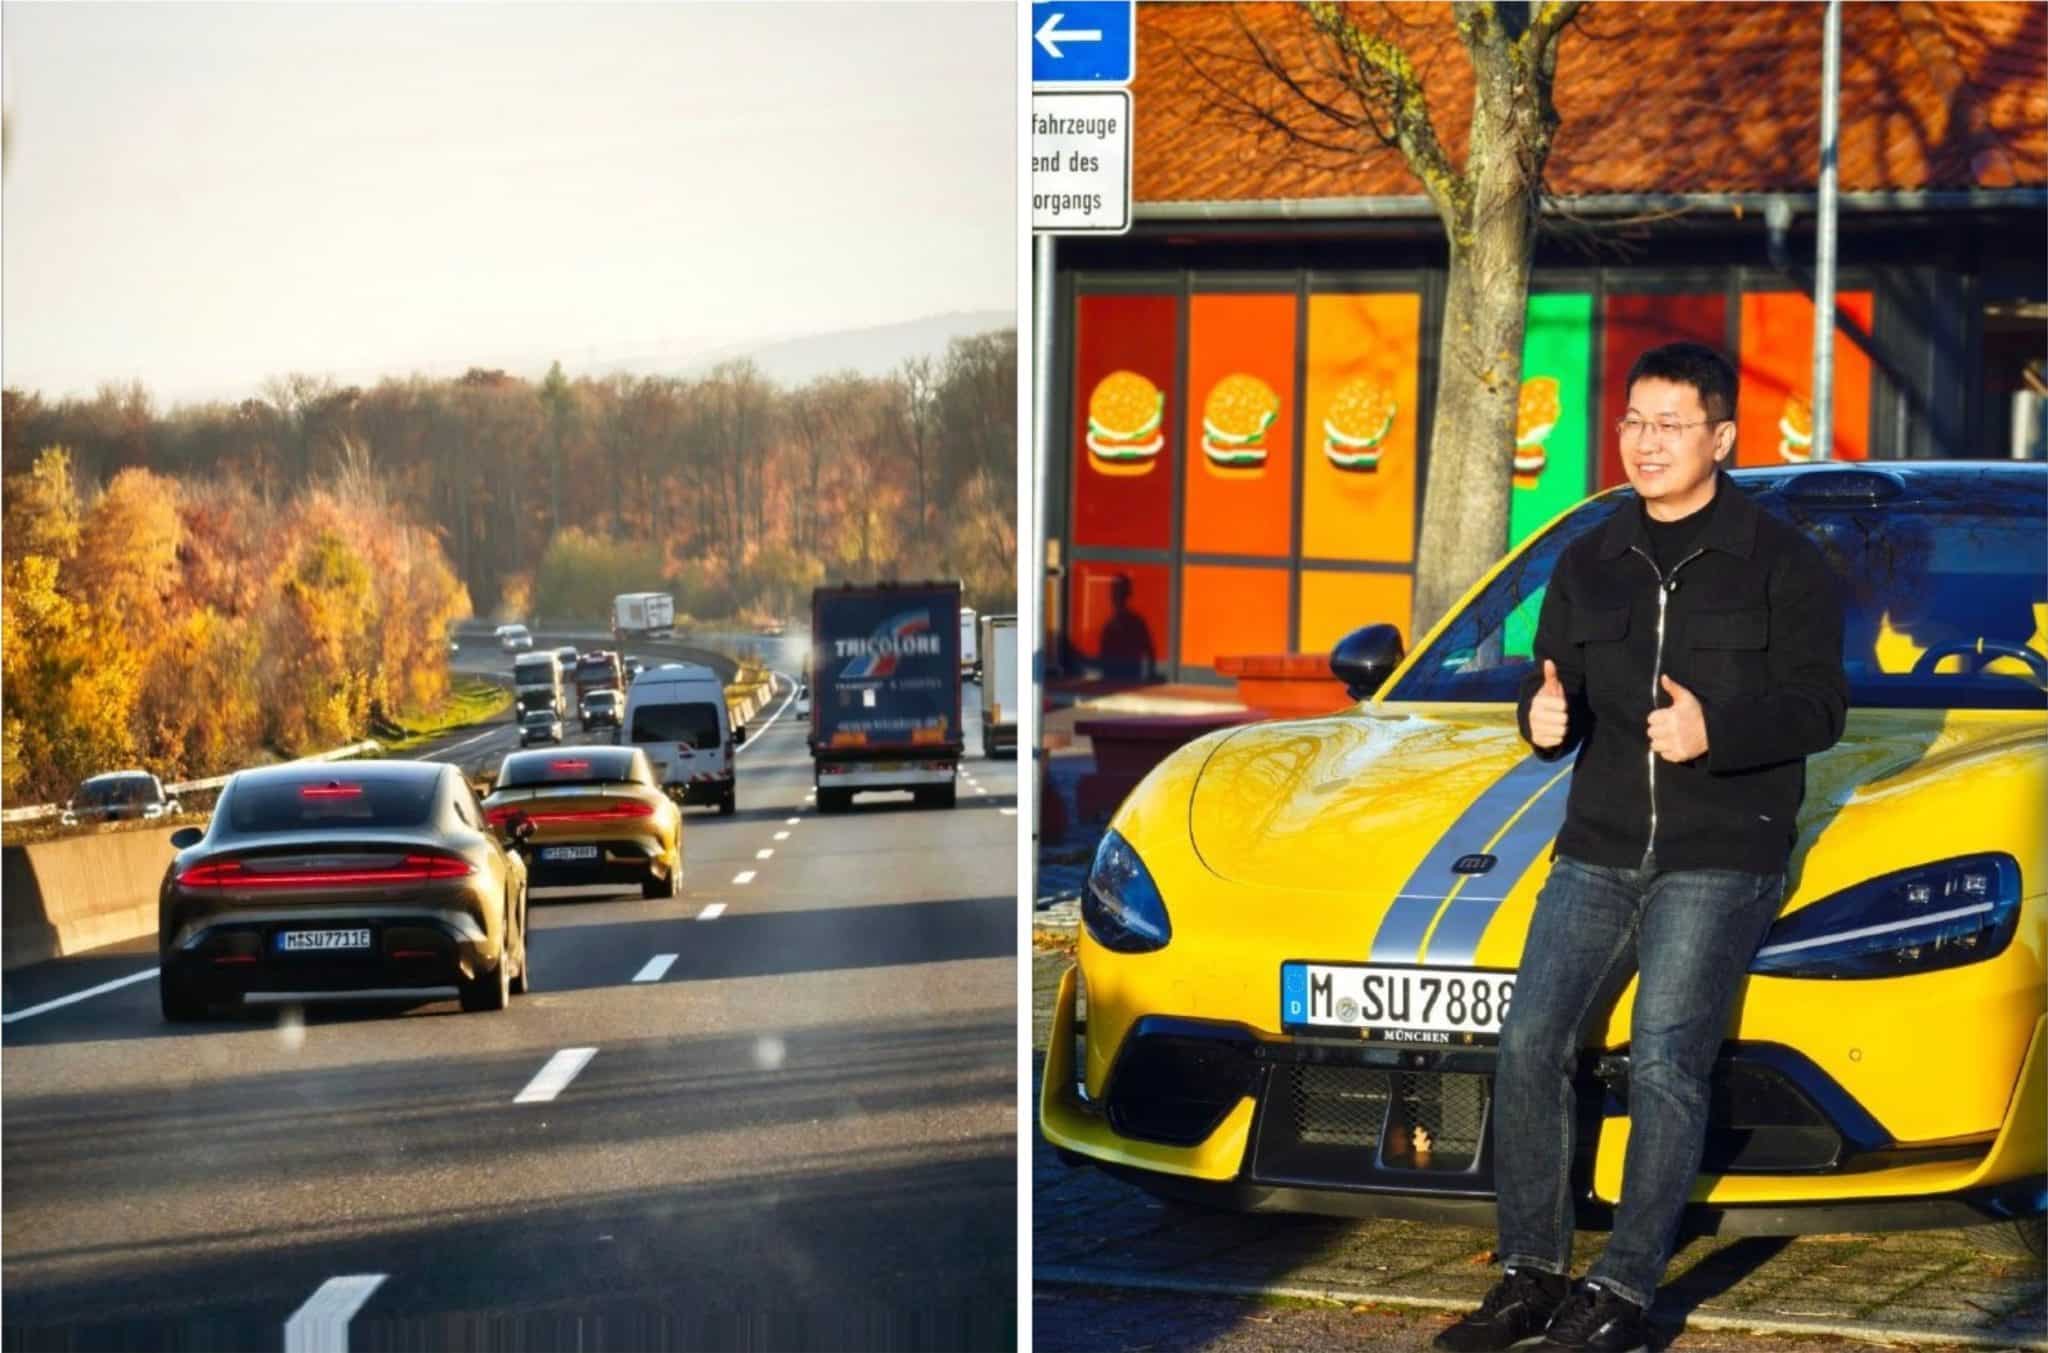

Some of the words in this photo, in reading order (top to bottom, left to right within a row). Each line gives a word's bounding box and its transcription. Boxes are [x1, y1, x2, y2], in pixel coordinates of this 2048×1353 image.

[1069, 150, 1099, 172] des
[1033, 194, 1102, 215] organgs
[834, 634, 941, 657] TRICOLORE
[1310, 972, 1333, 1018] M
[1383, 1028, 1450, 1044] MÜNCHEN
